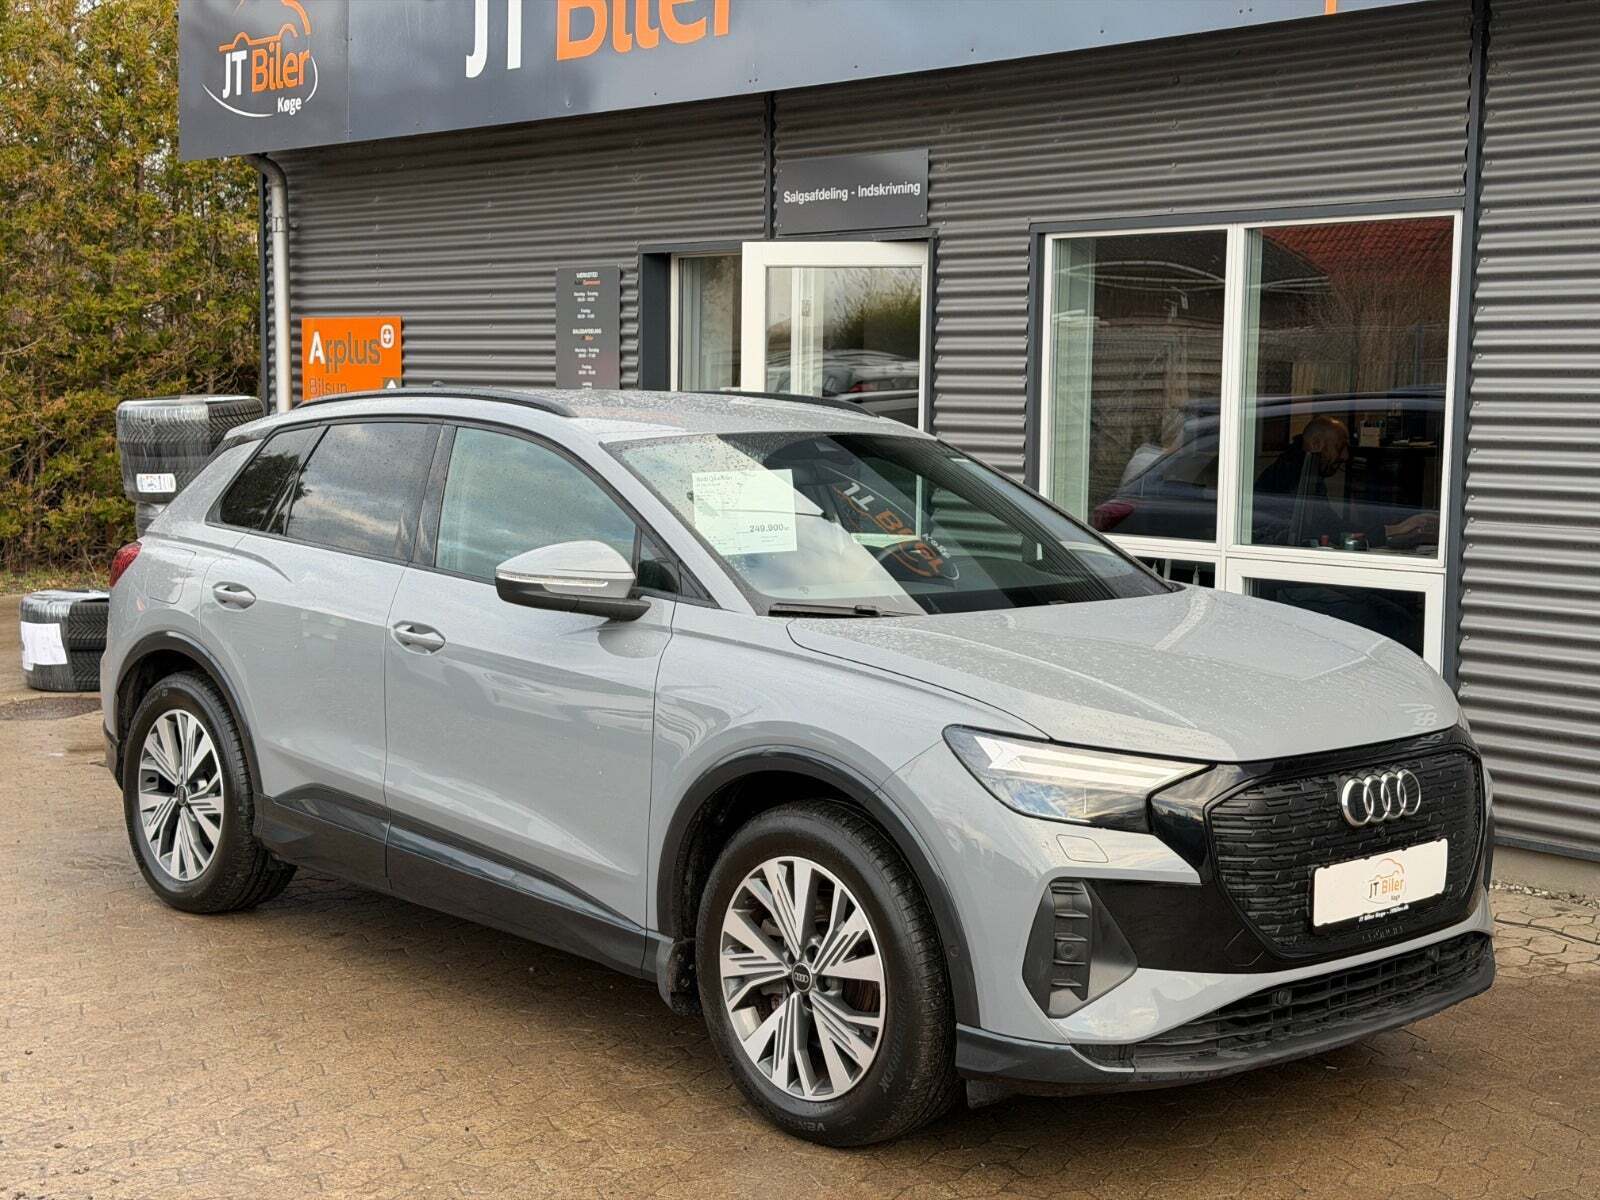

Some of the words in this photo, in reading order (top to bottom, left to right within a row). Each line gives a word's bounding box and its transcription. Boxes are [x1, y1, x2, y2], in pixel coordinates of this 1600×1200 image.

[223, 50, 247, 99] JT
[252, 42, 309, 92] Biler
[278, 97, 302, 115] Køge
[783, 187, 849, 205] Salgsafdeling
[858, 181, 921, 198] Indskrivning
[1369, 881, 1380, 898] JT
[1382, 878, 1405, 894] Biler
